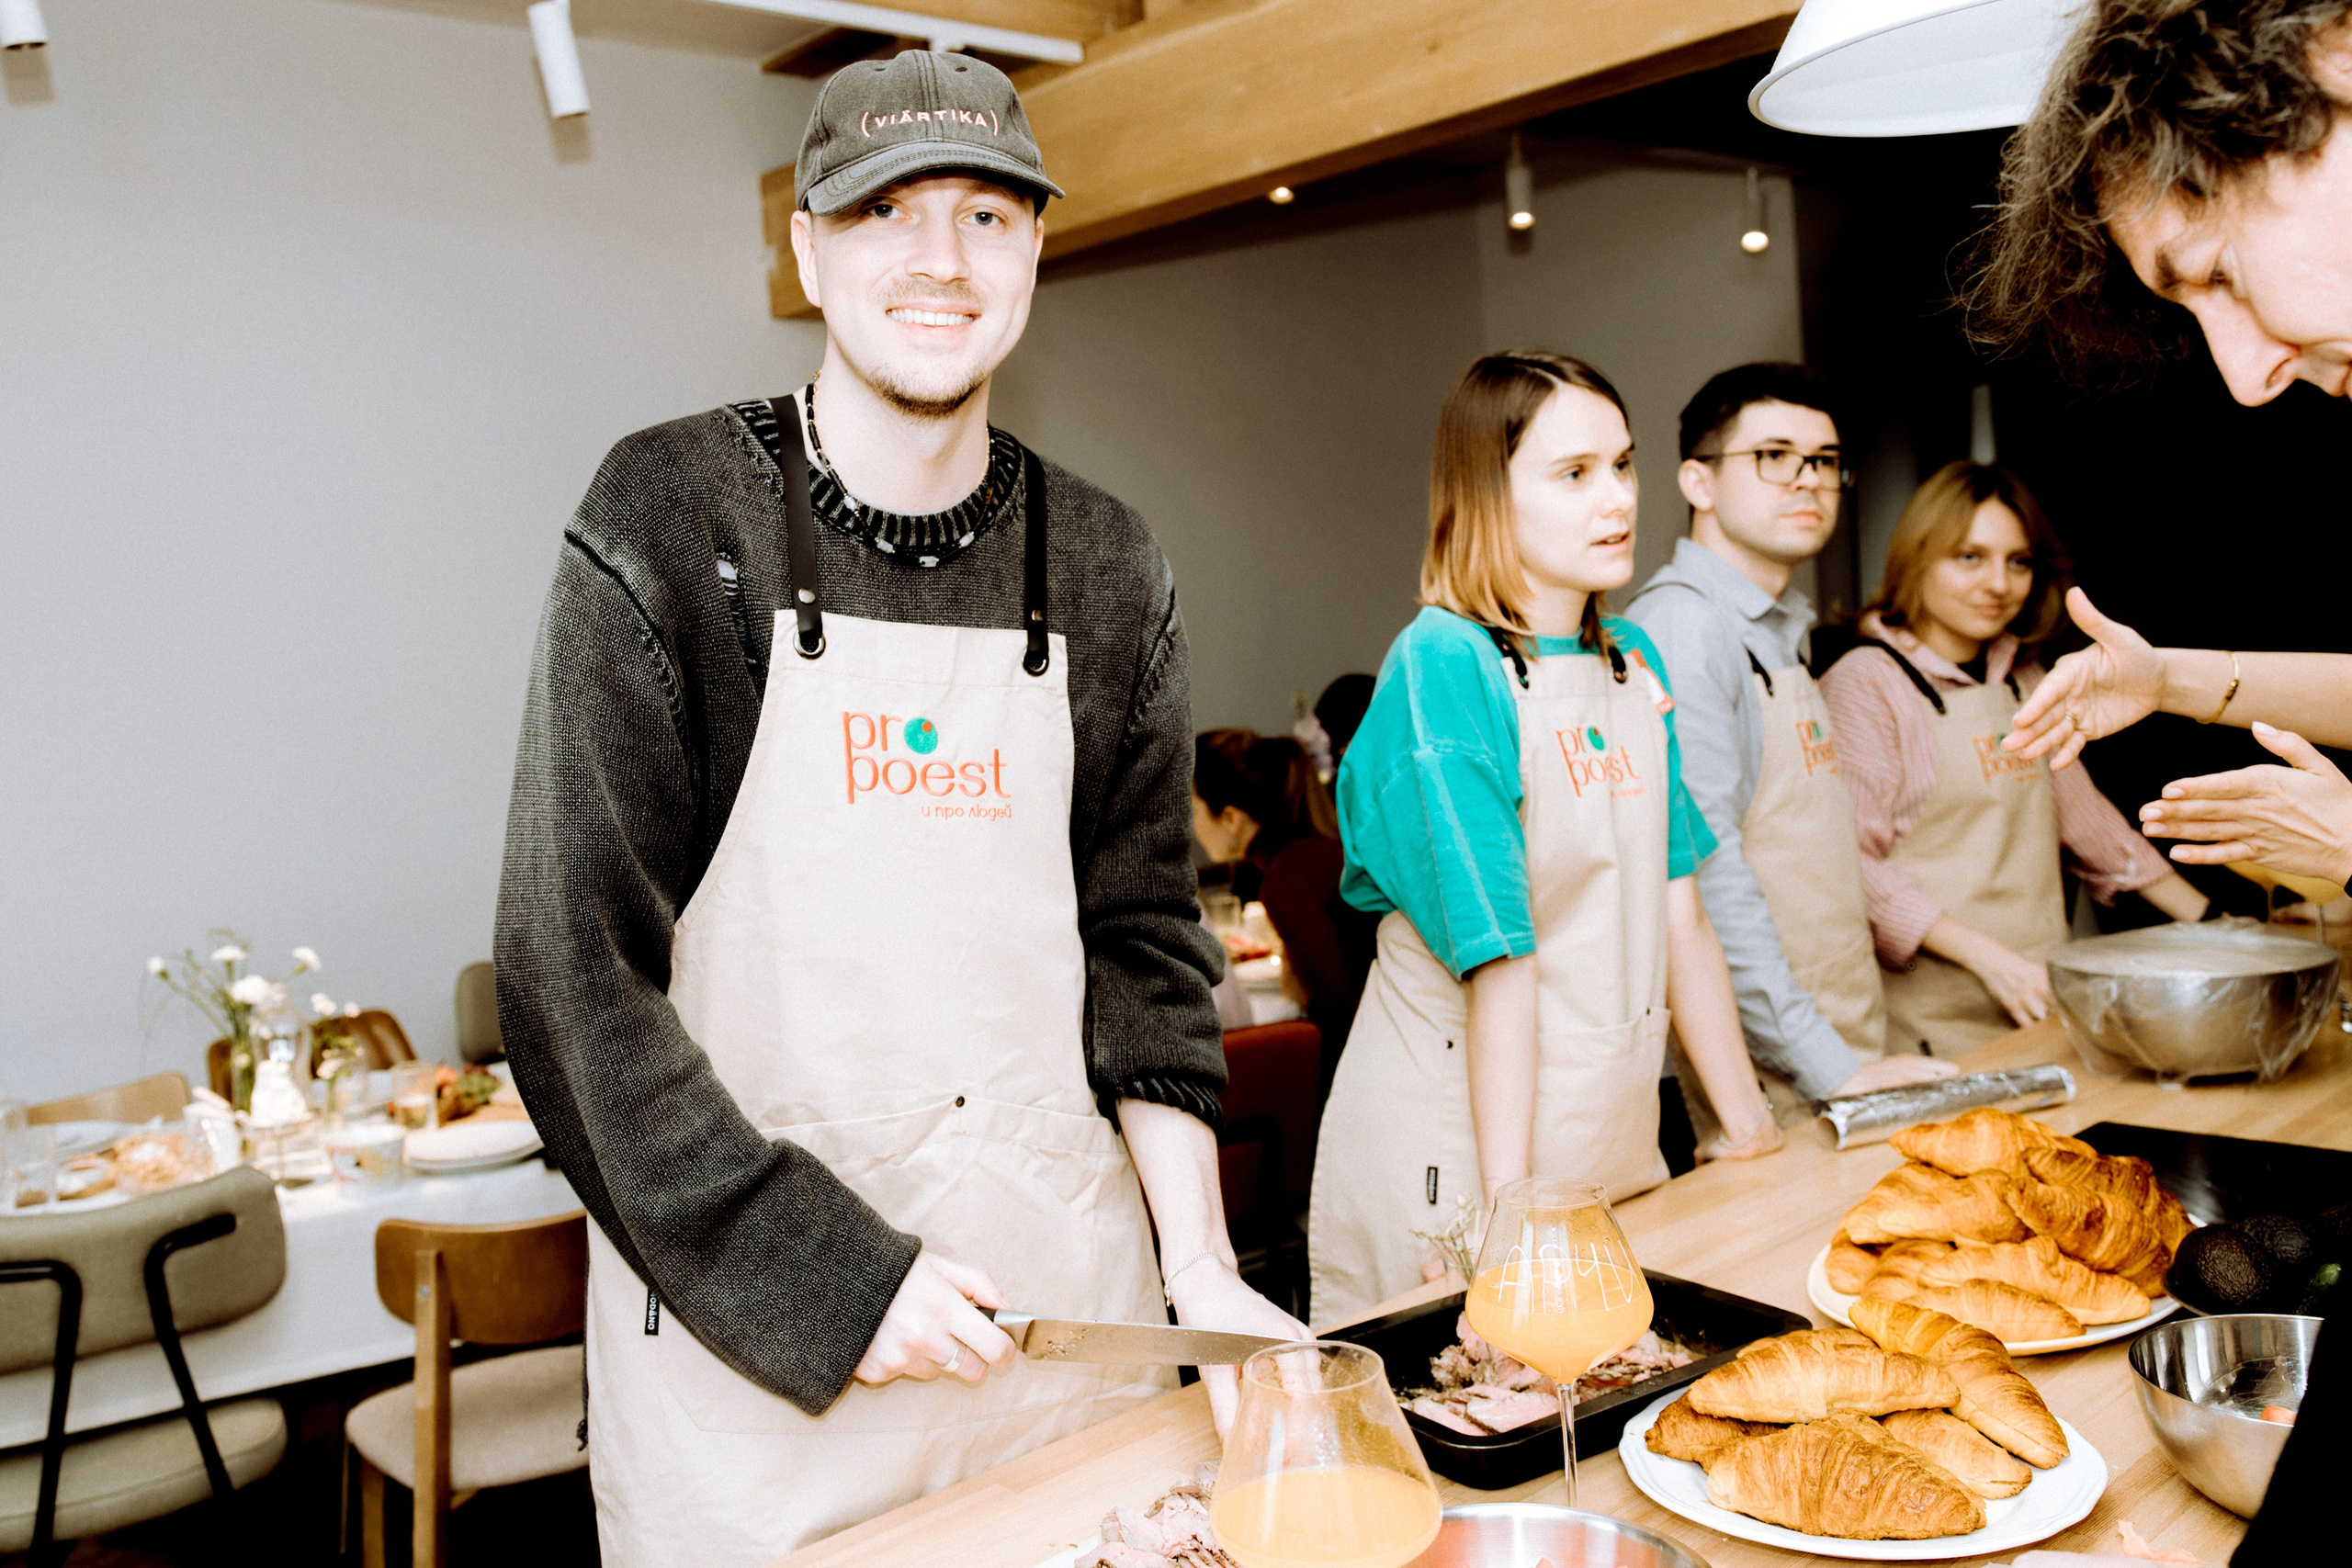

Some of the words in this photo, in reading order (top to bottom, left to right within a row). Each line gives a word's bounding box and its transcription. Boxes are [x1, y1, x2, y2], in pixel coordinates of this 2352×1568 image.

[845, 748, 1011, 805] poest
[921, 806, 931, 818] и
[935, 806, 965, 820] про
[968, 803, 1012, 821] людей
[647, 1293, 658, 1331] ODANO
